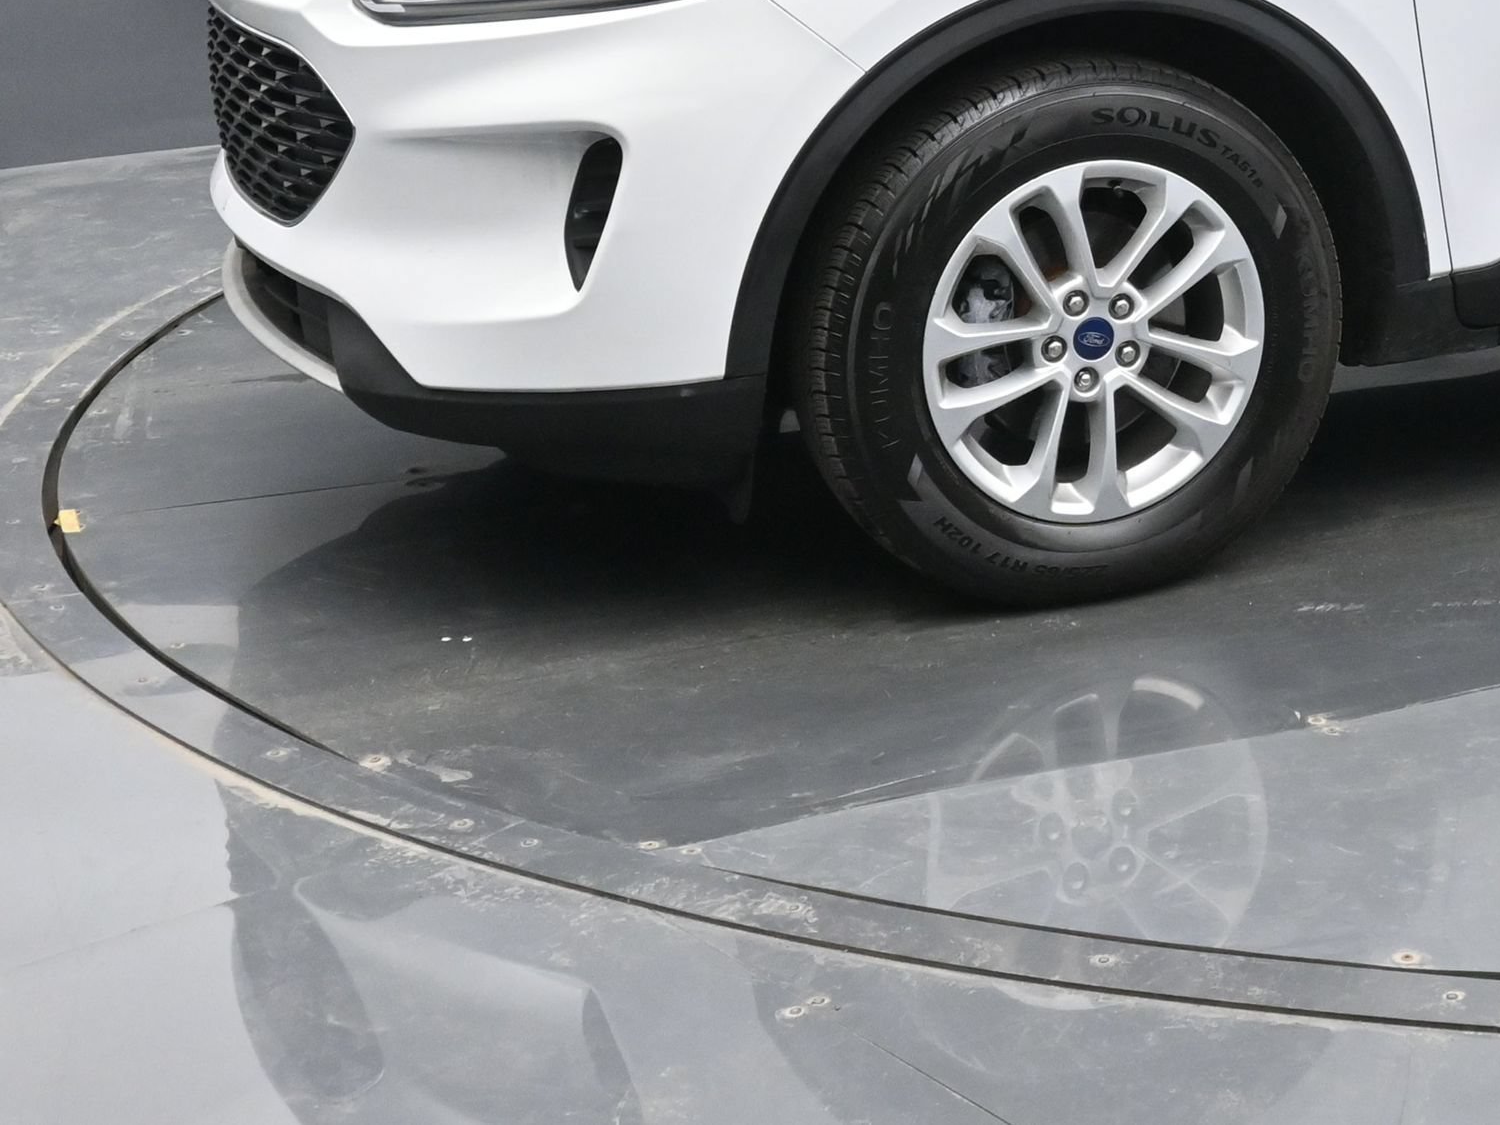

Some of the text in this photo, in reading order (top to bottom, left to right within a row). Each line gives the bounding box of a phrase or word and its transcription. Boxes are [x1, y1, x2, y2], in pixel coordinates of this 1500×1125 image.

[1091, 106, 1221, 148] SOLUS
[1080, 332, 1107, 346] Ford
[932, 515, 983, 555] 102H
[984, 551, 1029, 574] R17
